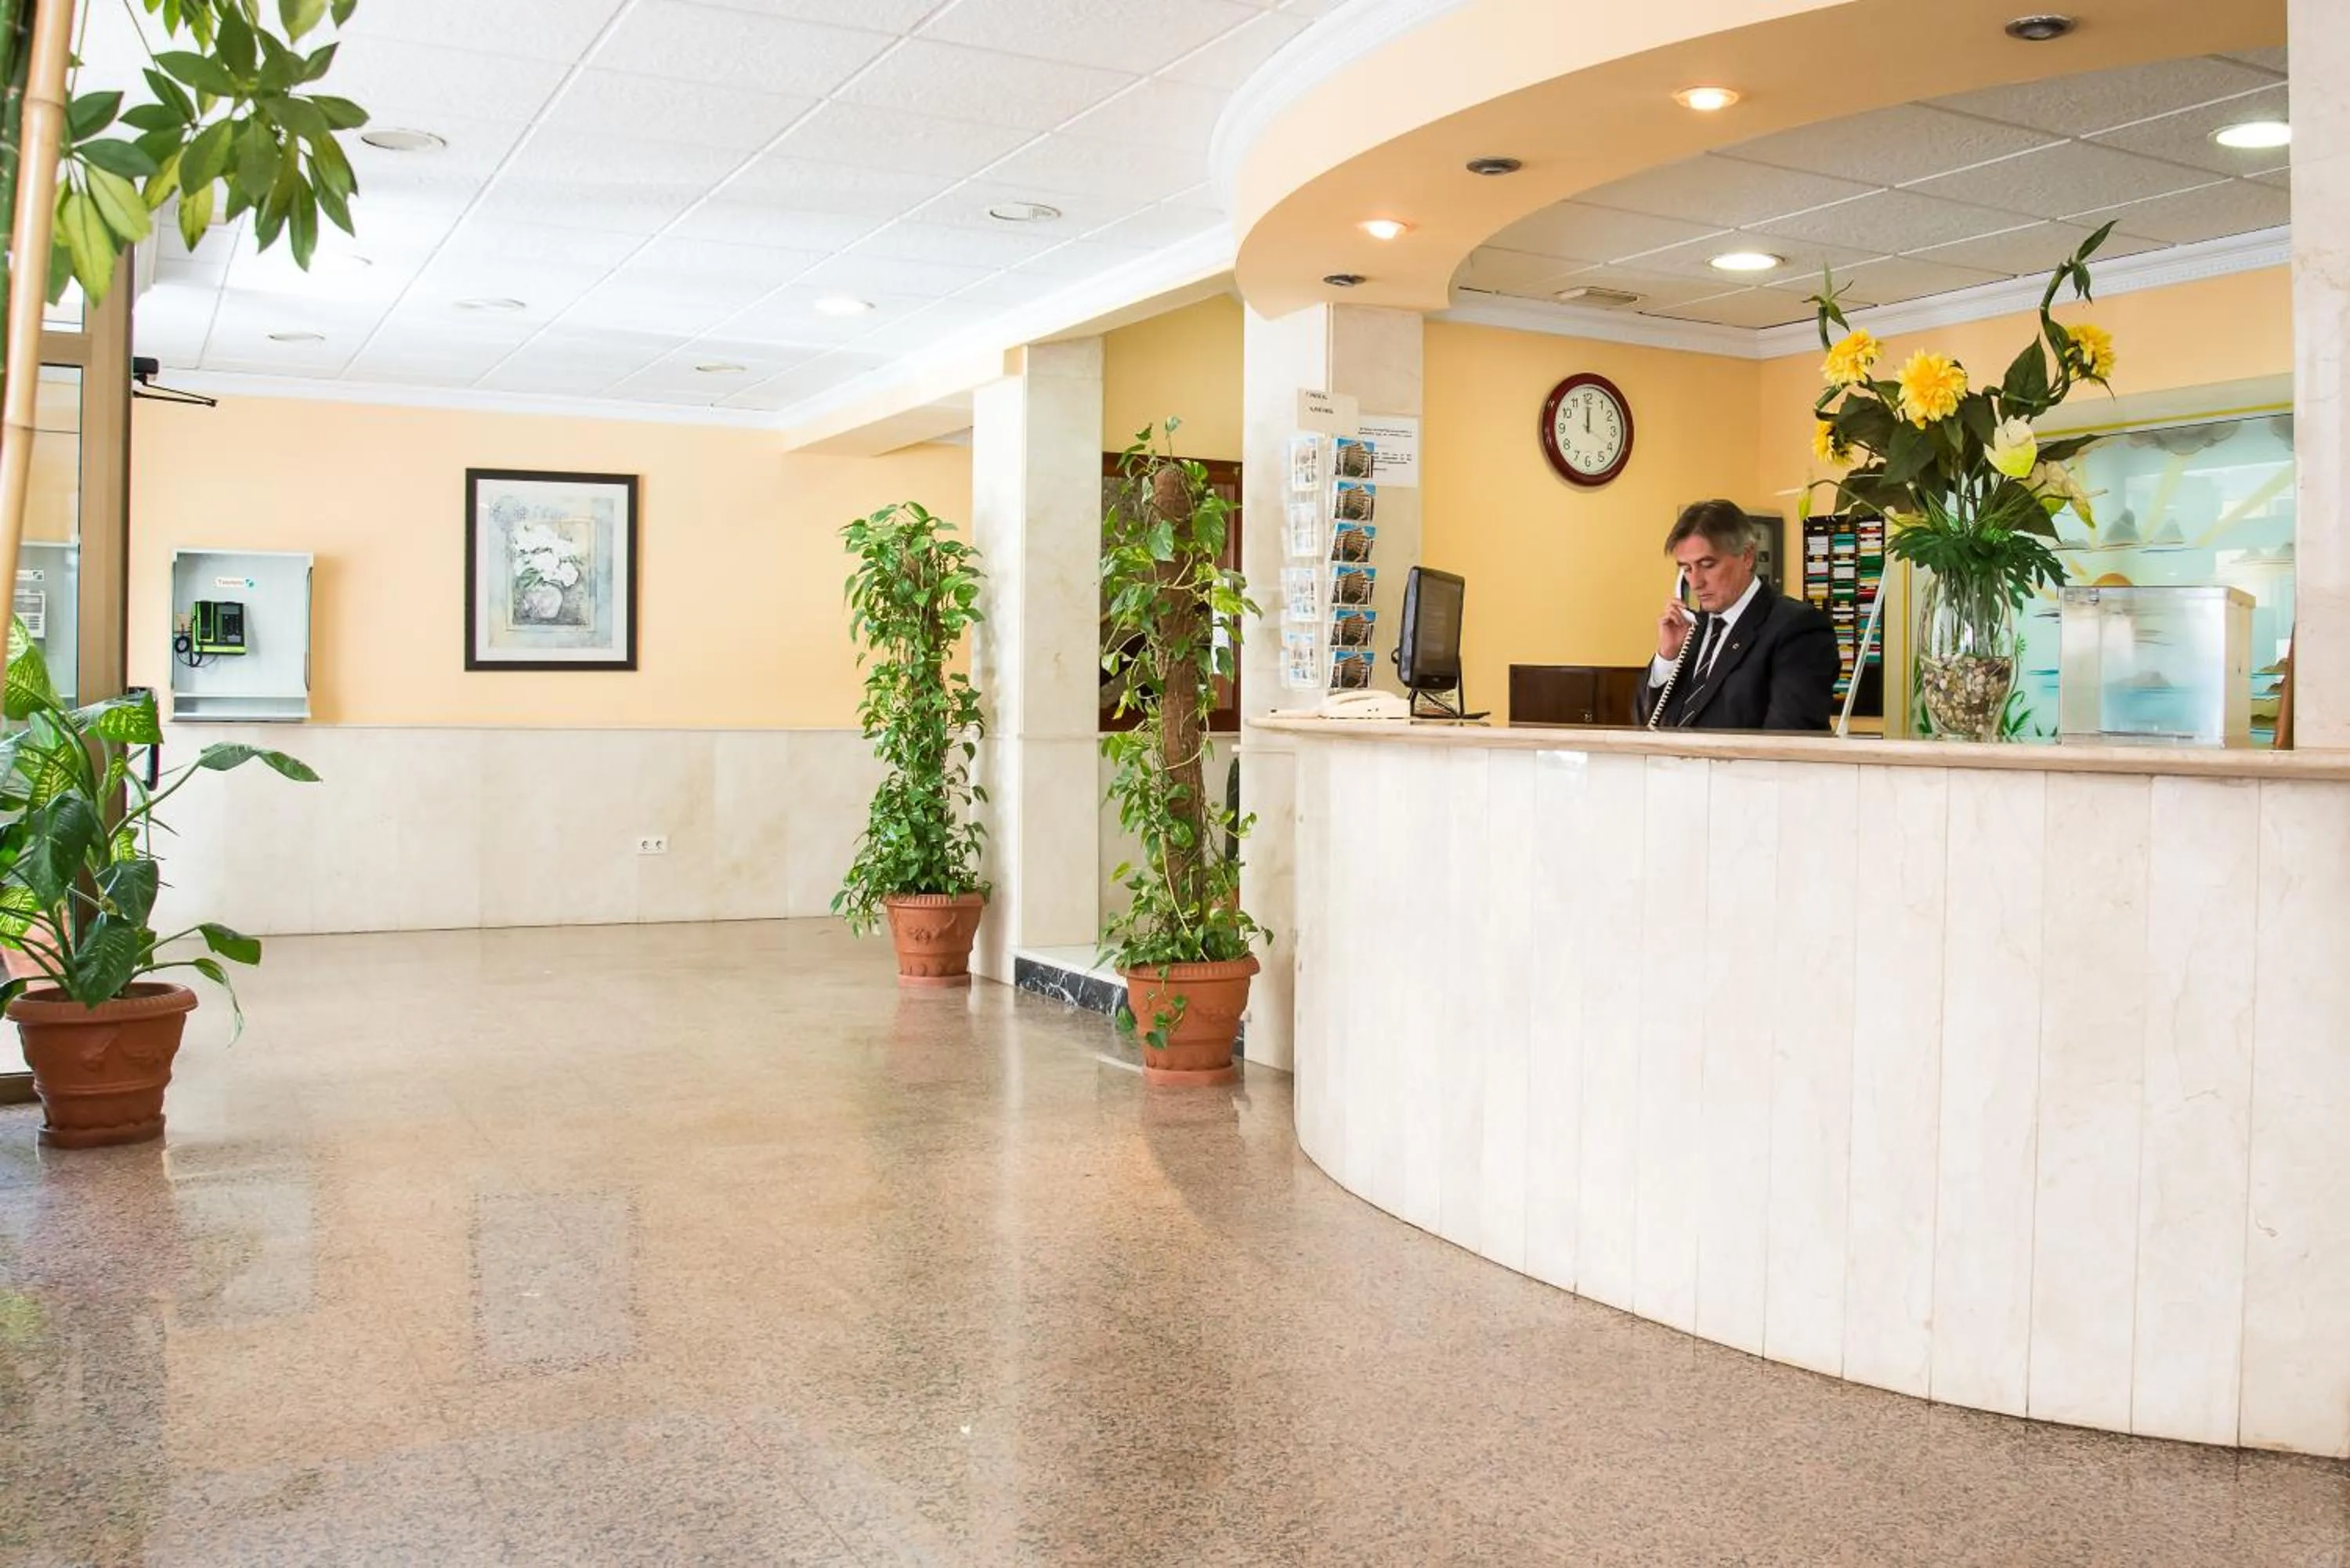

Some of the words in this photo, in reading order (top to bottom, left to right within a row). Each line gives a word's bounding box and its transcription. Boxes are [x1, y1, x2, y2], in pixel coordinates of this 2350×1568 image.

[1571, 397, 1578, 408] 11
[1582, 392, 1593, 405] 12
[1600, 399, 1604, 410] 1
[1563, 407, 1572, 419] 10
[1606, 410, 1613, 422] 2
[1558, 422, 1566, 434] 9
[1610, 425, 1617, 437] 3
[1563, 439, 1571, 450] 8
[1607, 442, 1613, 452] 4
[1574, 450, 1580, 461] 7
[1584, 455, 1591, 468] 6
[1597, 451, 1605, 463] 5
